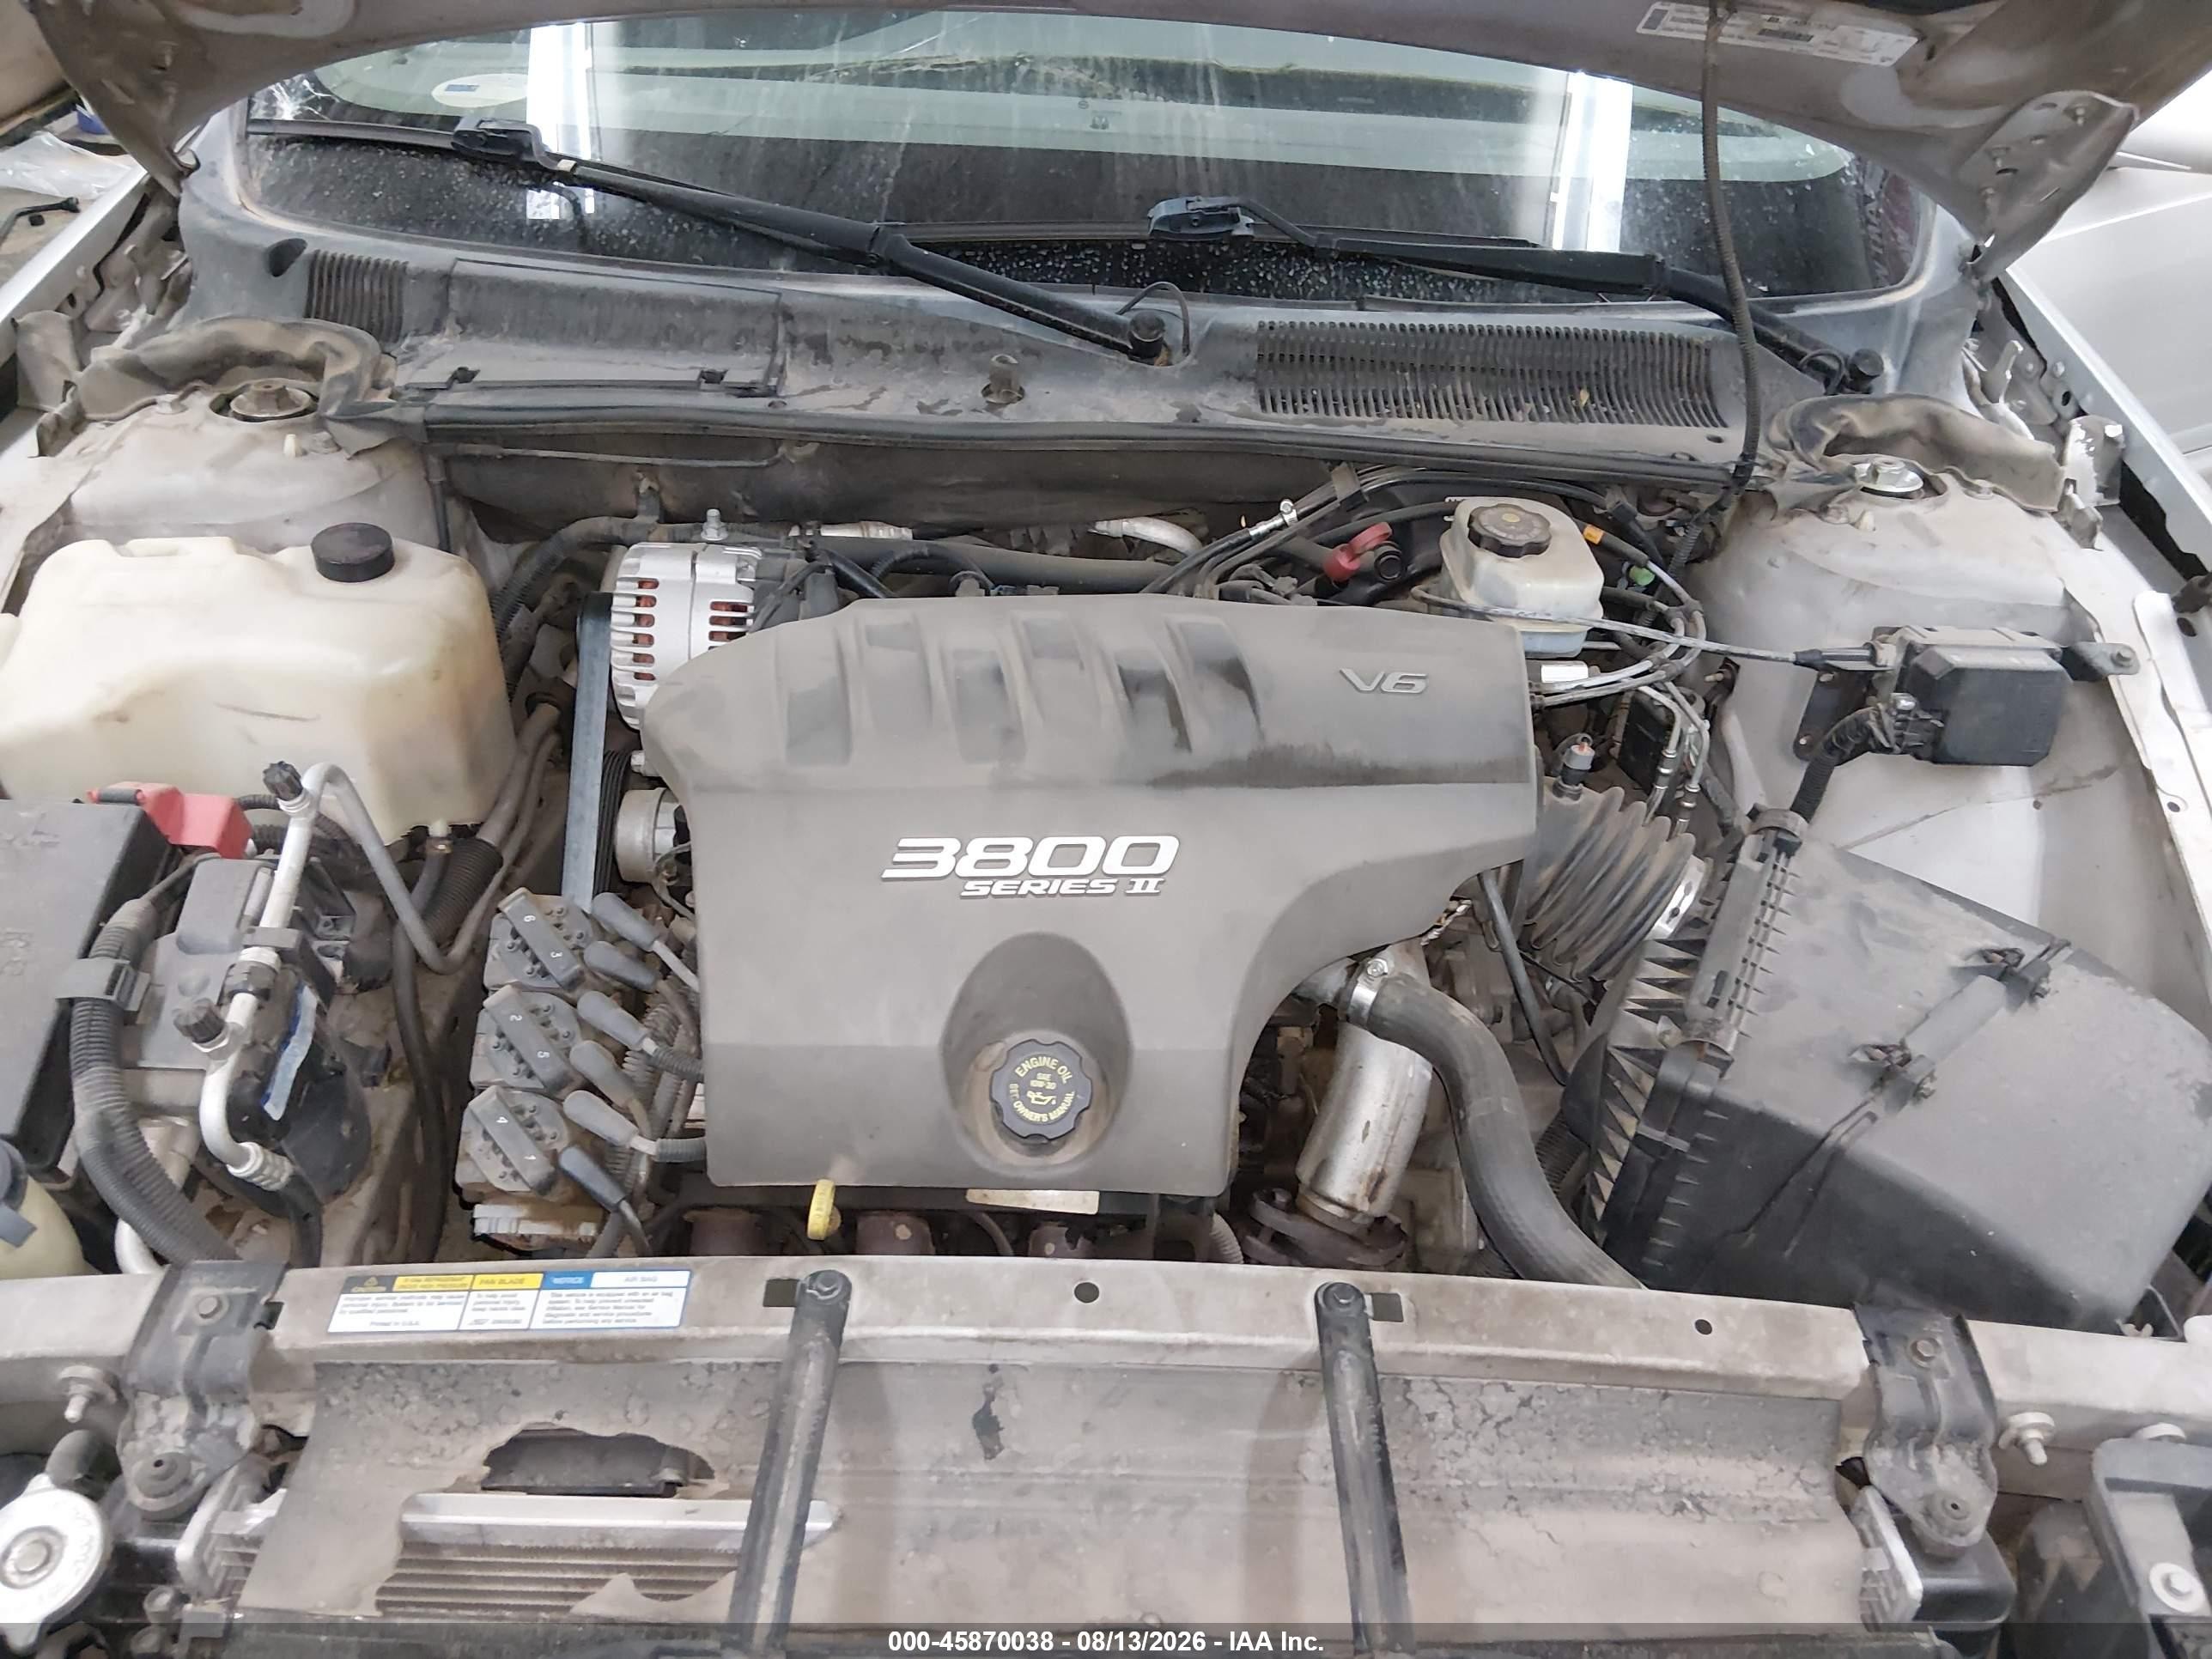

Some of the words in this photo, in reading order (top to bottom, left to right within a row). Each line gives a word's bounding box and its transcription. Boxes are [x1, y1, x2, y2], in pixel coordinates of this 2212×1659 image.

[1340, 669, 1427, 694] V6
[880, 836, 1180, 879] 3800
[960, 878, 1119, 898] SERIES
[1124, 878, 1165, 896] II
[1015, 1056, 1059, 1077] ENGINE
[1057, 1066, 1073, 1084] OIL
[1048, 1091, 1075, 1120] MANUAL
